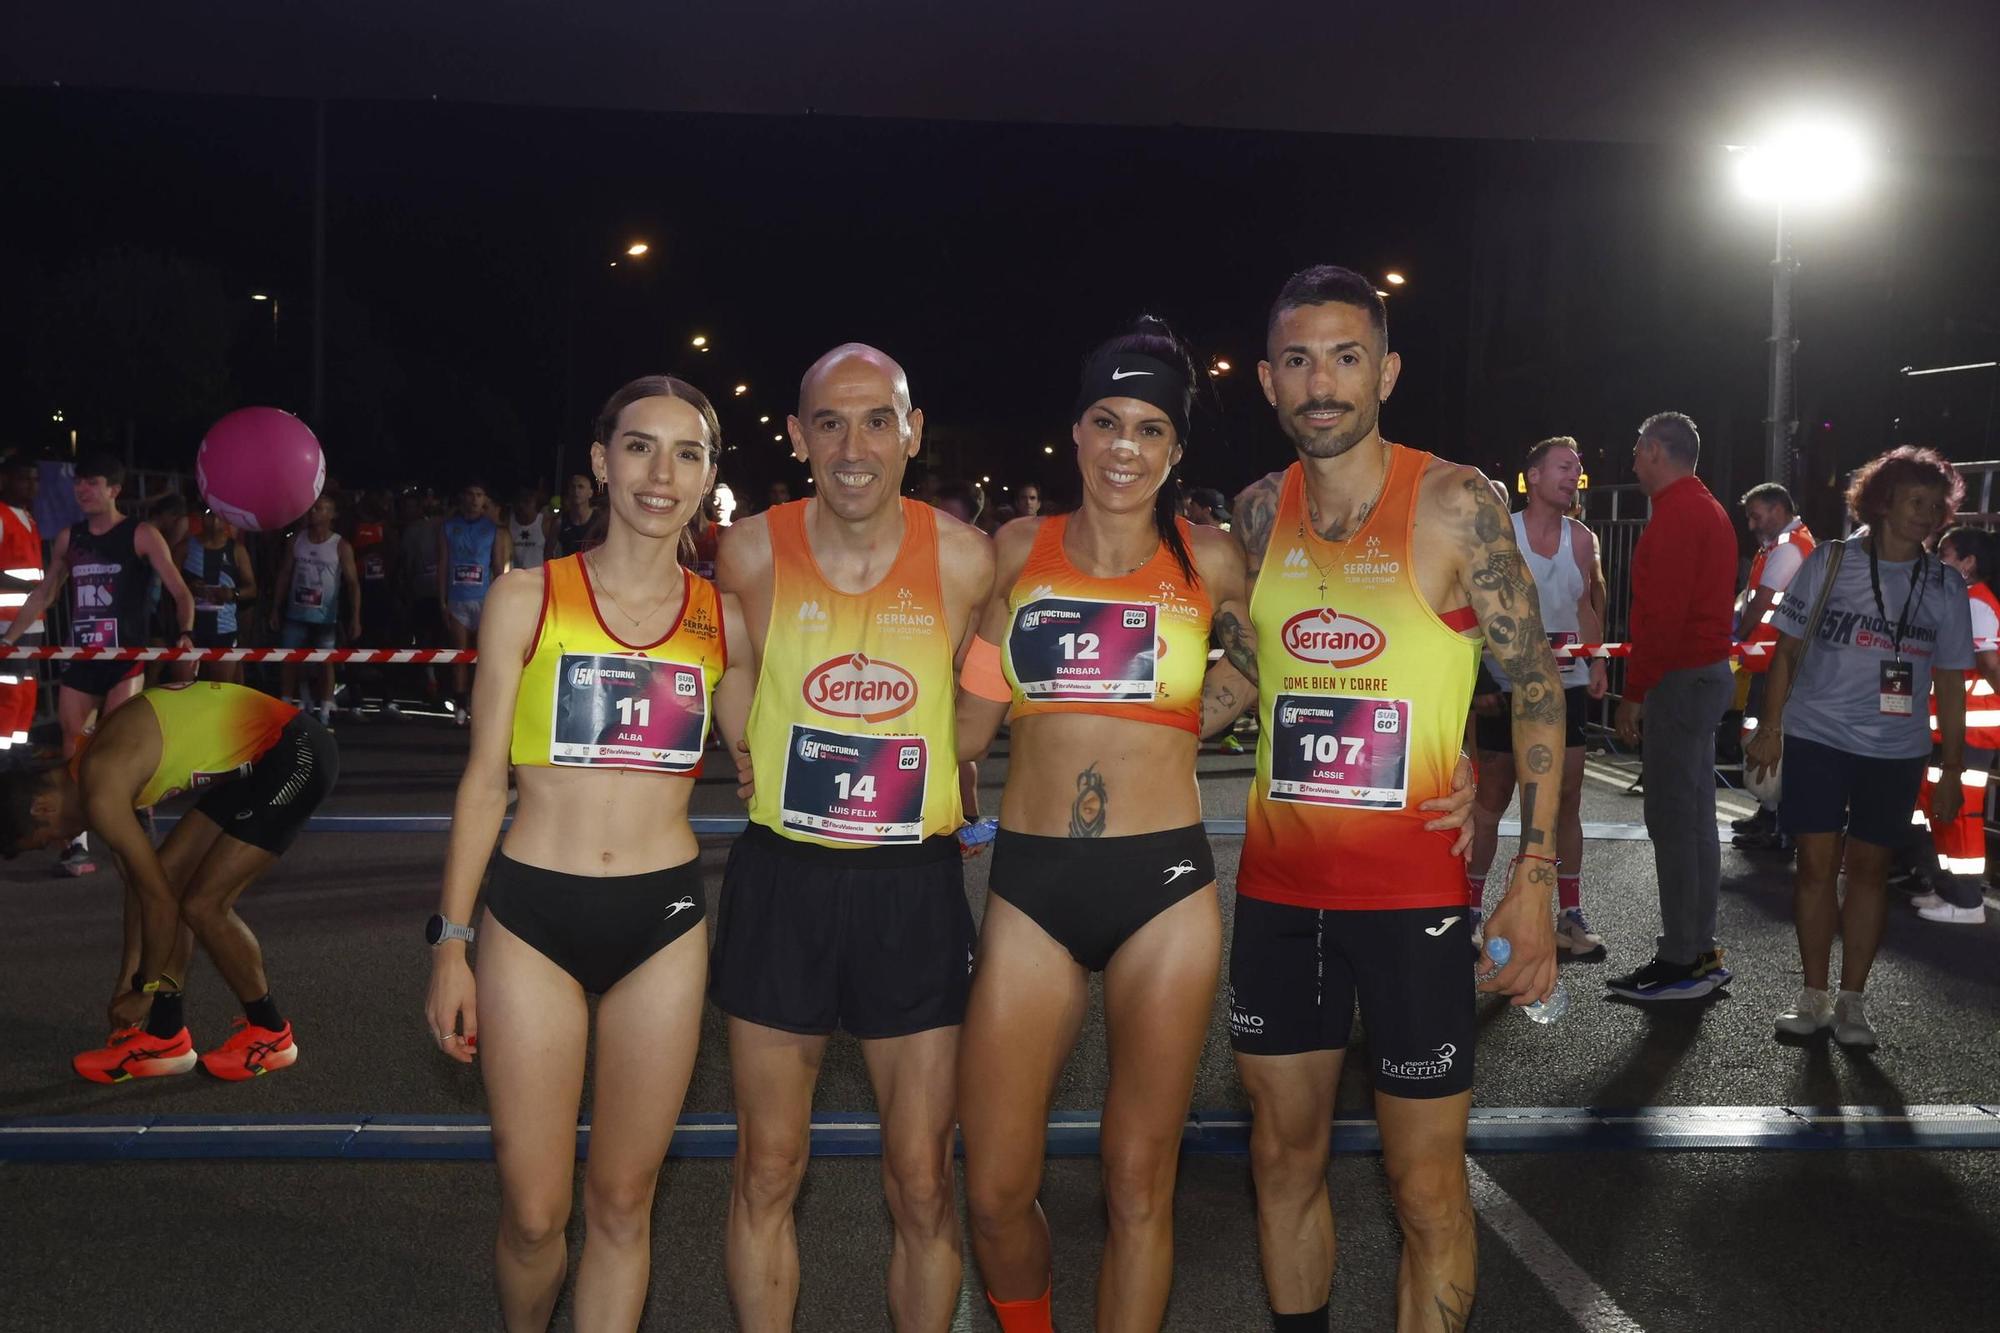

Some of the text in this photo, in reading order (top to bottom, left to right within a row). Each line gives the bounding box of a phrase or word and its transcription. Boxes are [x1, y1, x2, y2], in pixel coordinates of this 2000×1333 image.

[1343, 562, 1400, 574] SERRANO
[876, 613, 935, 626] SERRANO
[1023, 610, 1081, 628] 15K NOCTURNA
[81, 632, 104, 643] 278
[1290, 624, 1376, 650] Serrano
[1058, 633, 1100, 660] 12
[573, 668, 636, 686] 15K NOCTURNA
[1056, 666, 1101, 675] BARBARA
[677, 675, 694, 683] SUB
[1283, 677, 1388, 691] COME BIEN Y CORRE
[814, 674, 910, 703] Serrano
[616, 697, 650, 727] 11
[1282, 707, 1299, 724] 15K
[1299, 708, 1334, 718] NOCTURNA
[1377, 711, 1397, 719] SUB
[618, 732, 643, 742] ALBA
[800, 740, 820, 759] 15K
[820, 743, 859, 757] NOCTURNA
[902, 749, 918, 757] SUB
[1300, 733, 1365, 765] 107
[1312, 770, 1344, 780] LASSIE
[834, 772, 877, 803] 14
[828, 805, 878, 818] LUIS FELIX
[1382, 1057, 1447, 1076] Paterna
